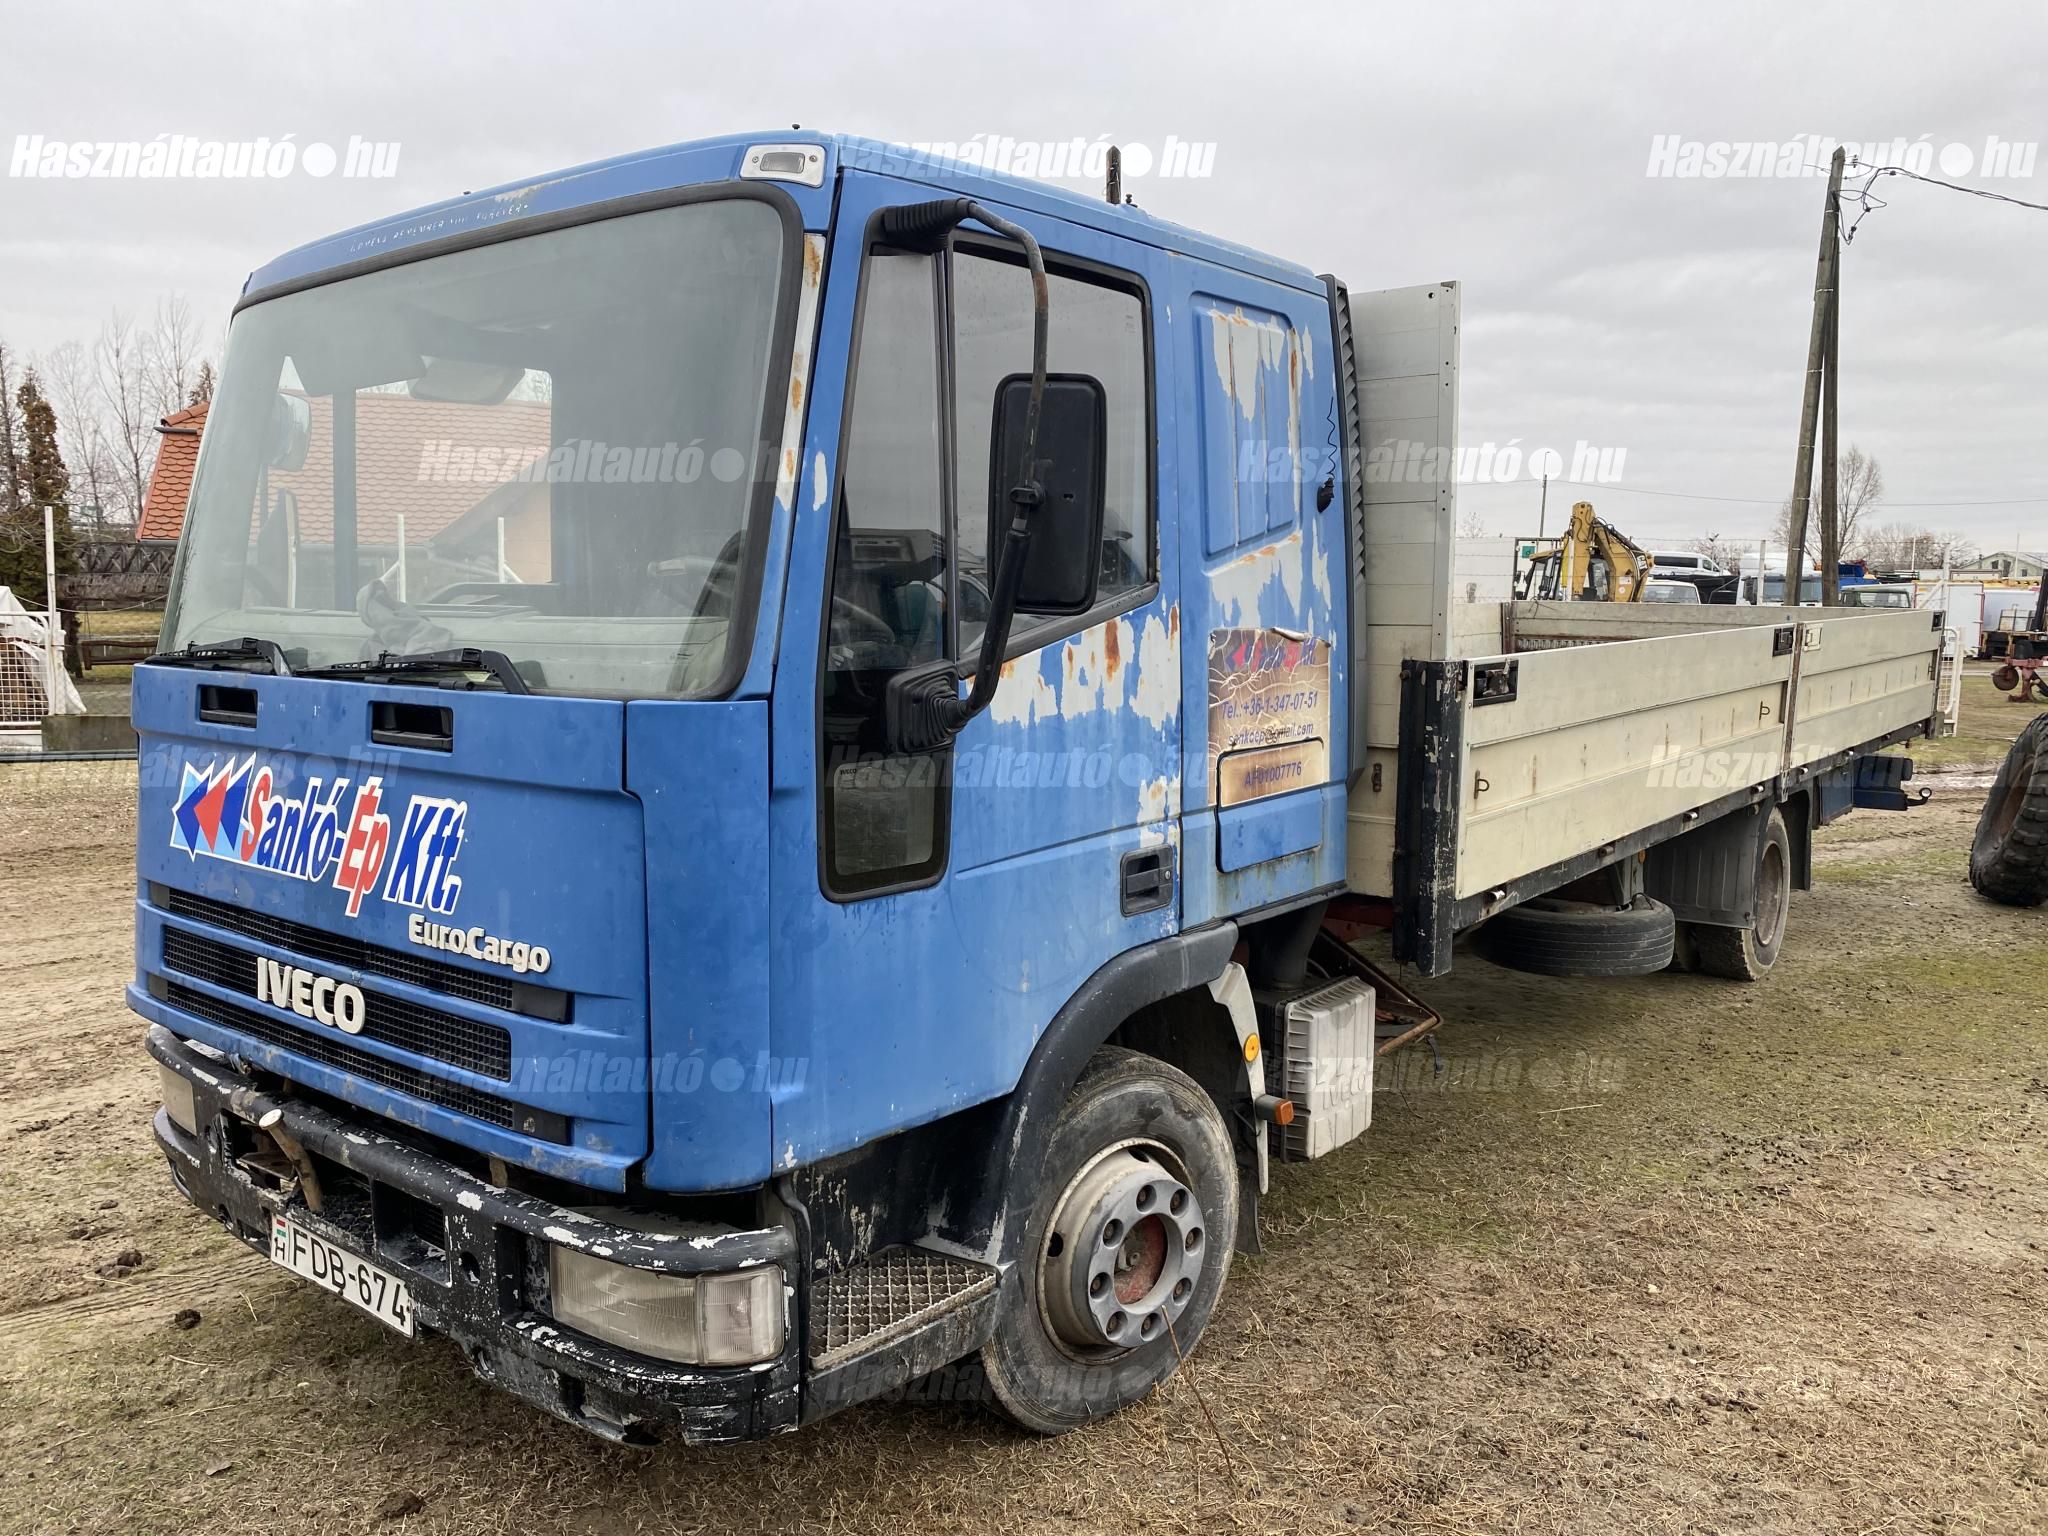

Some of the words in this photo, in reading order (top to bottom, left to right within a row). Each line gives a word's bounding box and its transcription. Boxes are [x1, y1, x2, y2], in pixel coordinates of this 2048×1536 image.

[385, 796, 468, 915] Kft.
[407, 913, 552, 974] EuroCargo
[256, 956, 366, 1035] IVECO
[293, 1227, 406, 1327] FDB-674
